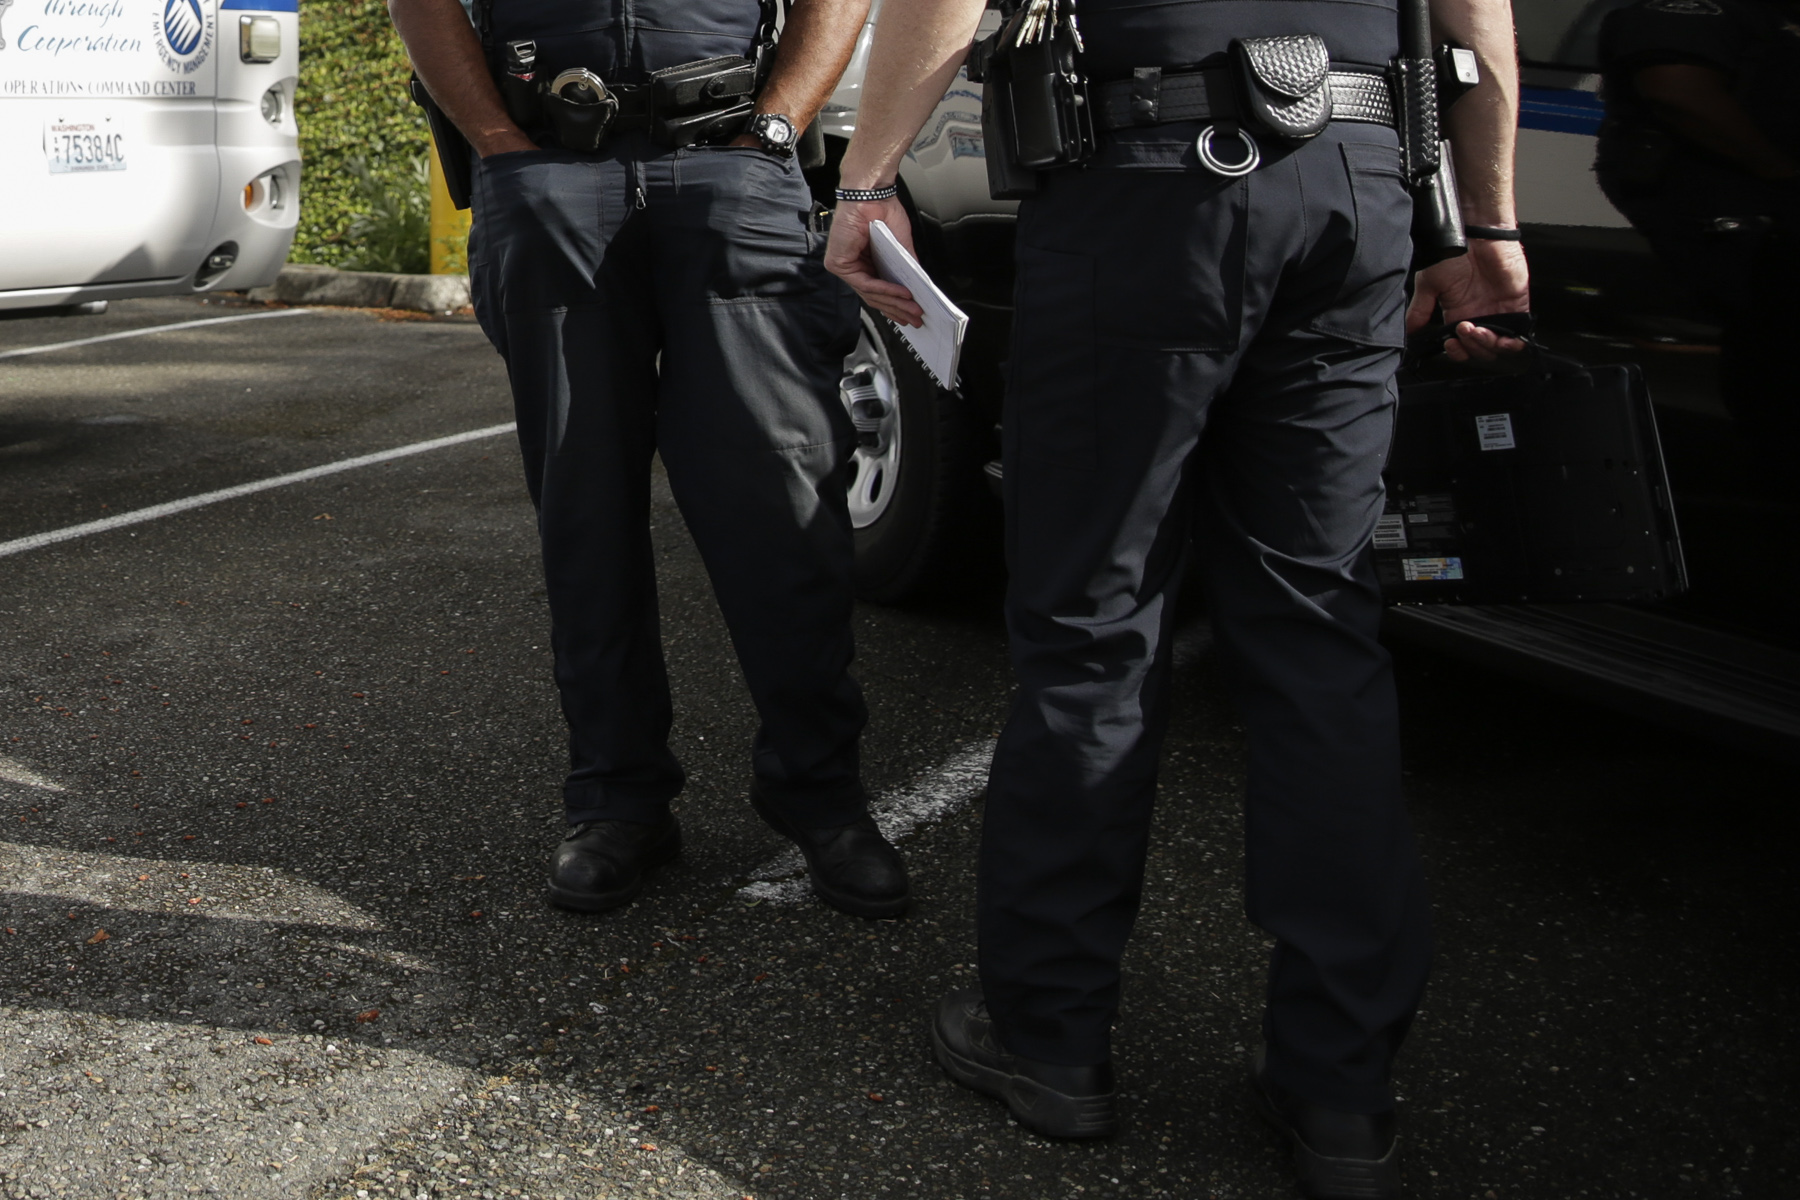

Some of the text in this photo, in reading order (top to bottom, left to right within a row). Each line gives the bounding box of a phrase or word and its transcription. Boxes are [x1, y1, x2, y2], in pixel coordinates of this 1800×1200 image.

[16, 25, 142, 57] Cooperation
[152, 11, 214, 75] EMERGENCY MANAGEMENT
[4, 79, 84, 96] OPERATIONS
[88, 80, 151, 96] COMMAND
[154, 80, 197, 97] CENTER
[50, 123, 96, 133] WASHINGTON
[62, 133, 124, 164] 75384C
